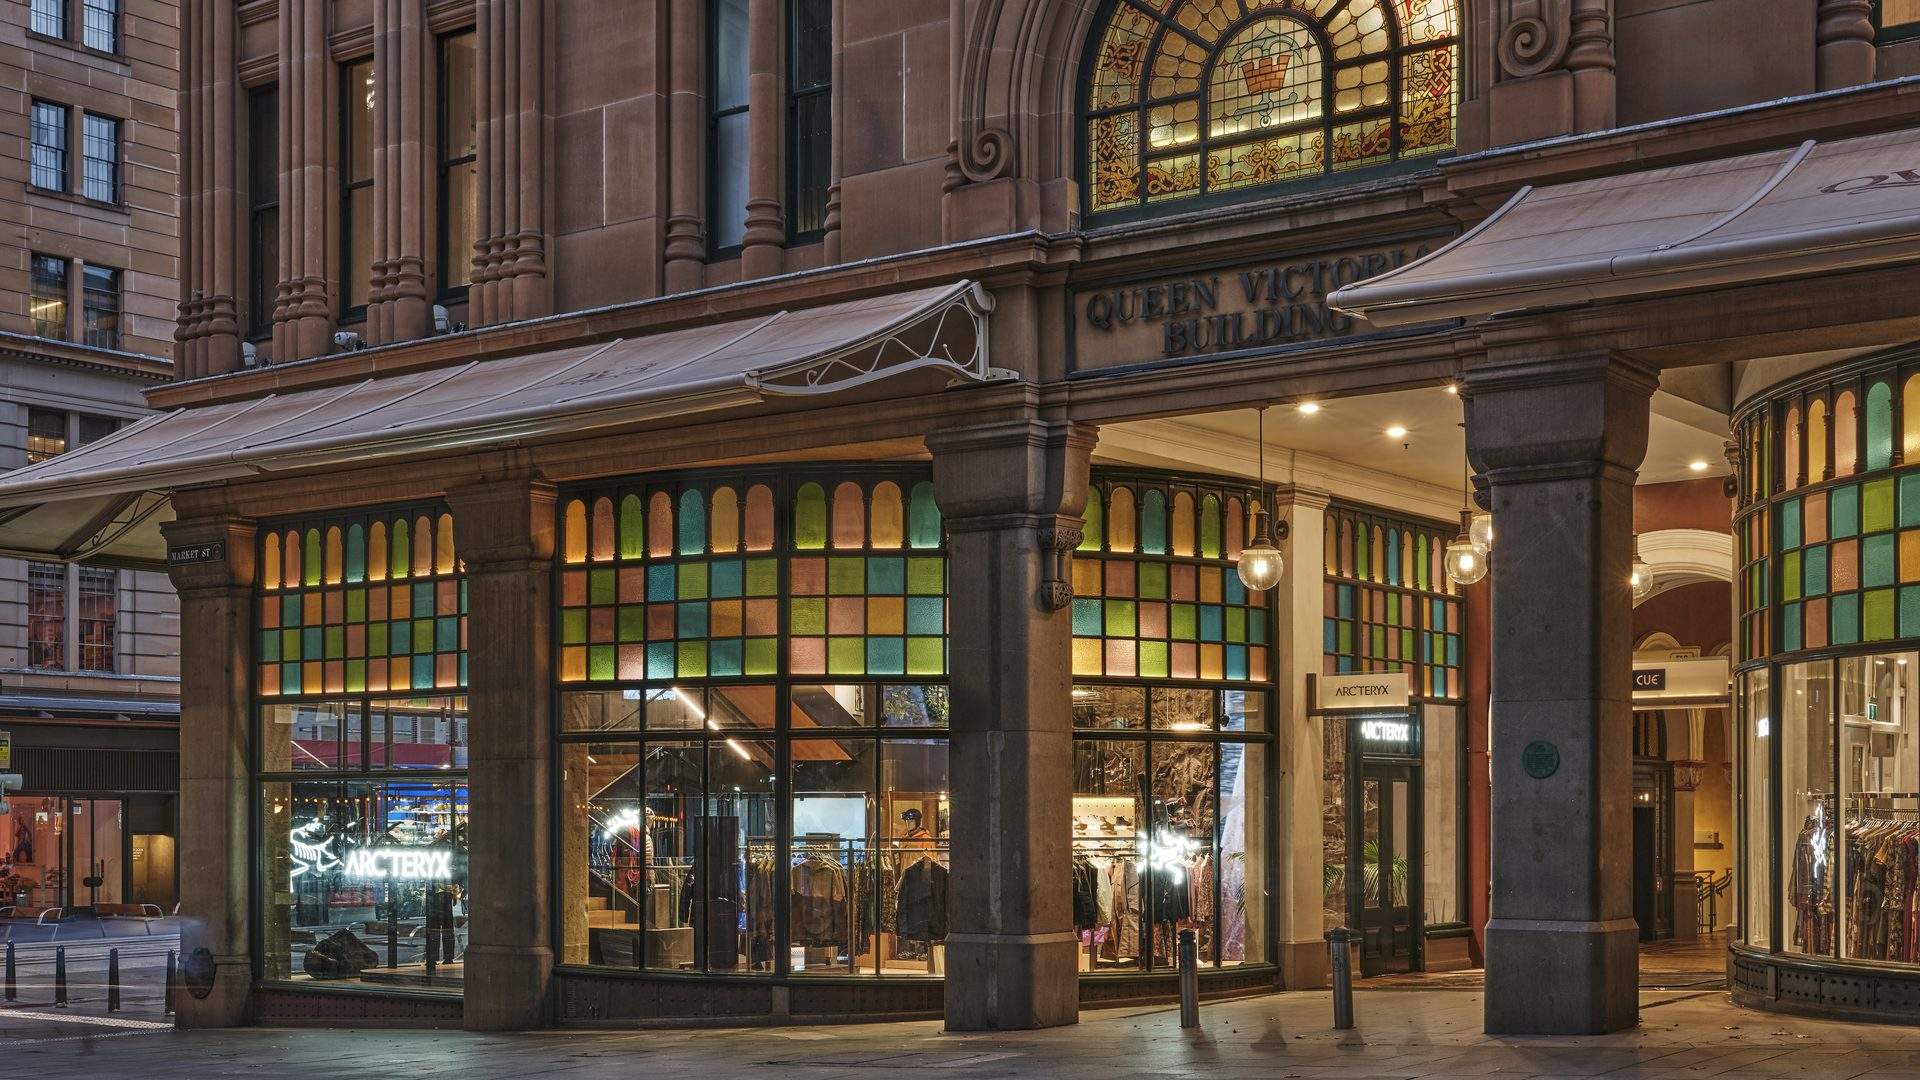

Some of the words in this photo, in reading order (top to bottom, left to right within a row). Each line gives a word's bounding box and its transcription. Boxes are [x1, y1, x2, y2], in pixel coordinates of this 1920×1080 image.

[1087, 272, 1218, 329] QUEEN
[1162, 303, 1351, 354] BUILDING
[171, 550, 199, 561] MARKET
[201, 548, 211, 558] ST
[1636, 674, 1660, 686] CUE
